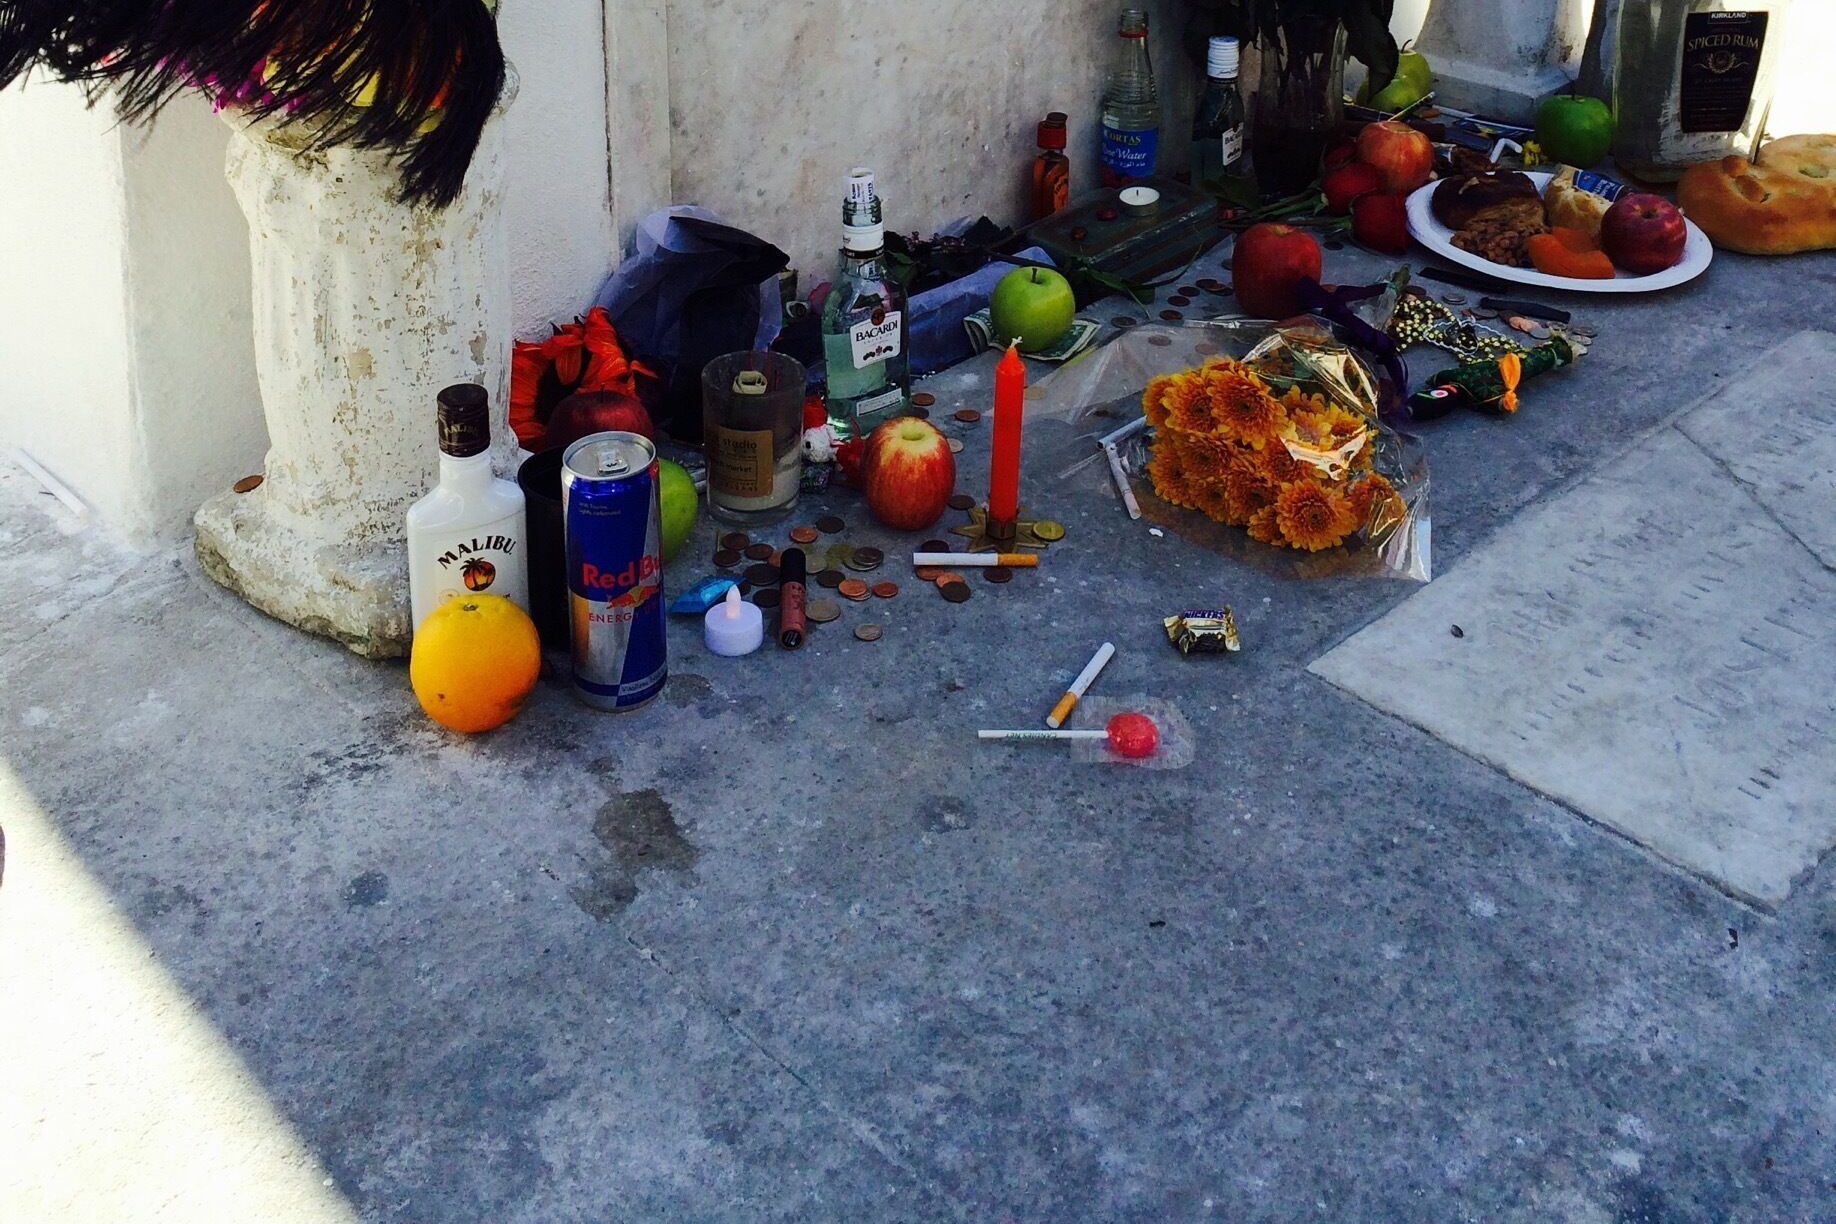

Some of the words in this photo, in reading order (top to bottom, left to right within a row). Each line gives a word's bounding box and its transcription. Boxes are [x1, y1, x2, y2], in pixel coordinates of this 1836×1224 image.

[1688, 34, 1731, 52] SPICED
[1732, 35, 1760, 50] RUM
[1116, 148, 1147, 160] Water
[856, 320, 898, 342] BACARDI
[437, 535, 516, 570] MALIBU
[582, 561, 636, 589] Red
